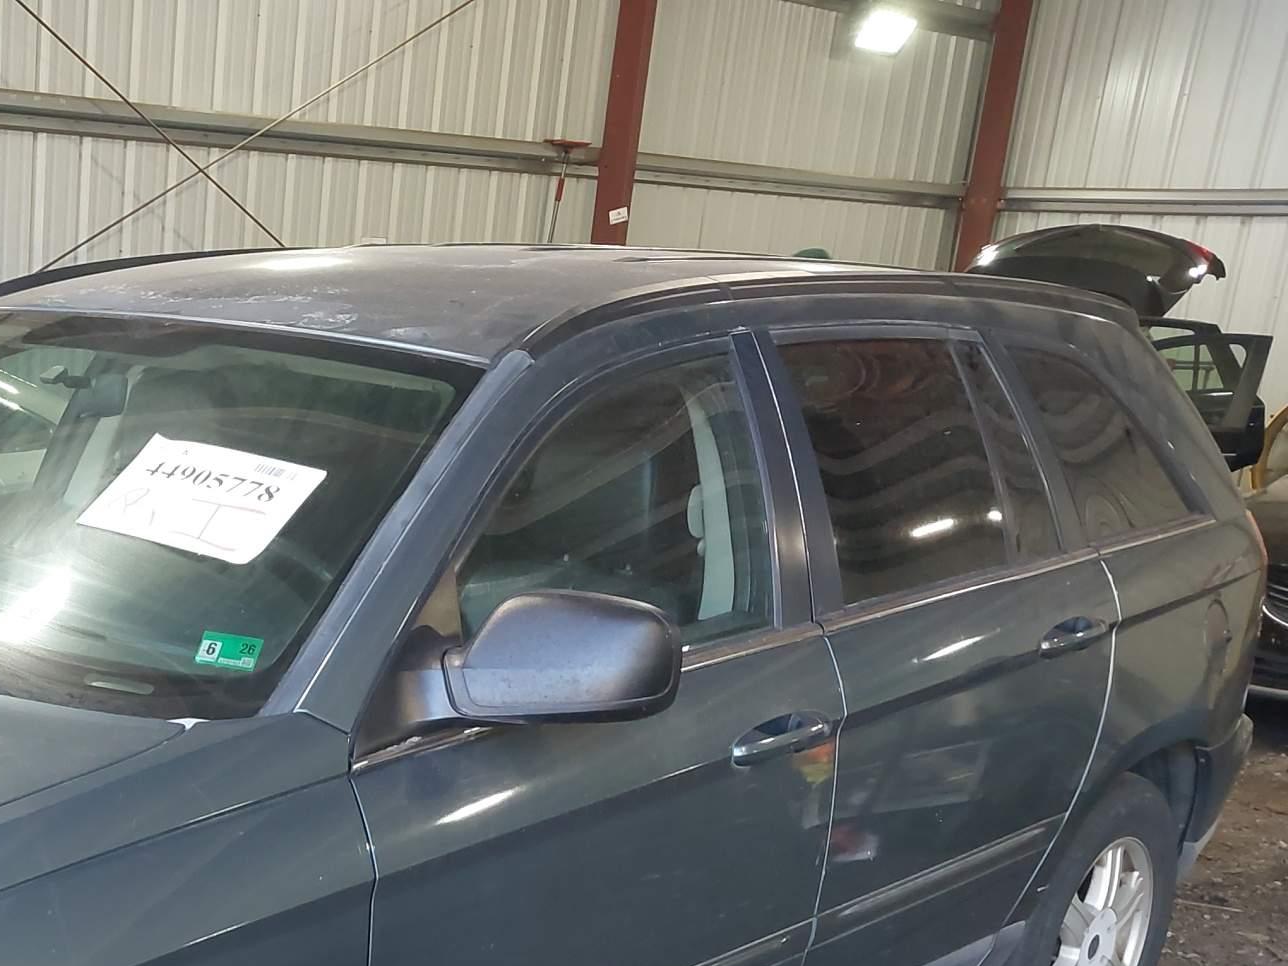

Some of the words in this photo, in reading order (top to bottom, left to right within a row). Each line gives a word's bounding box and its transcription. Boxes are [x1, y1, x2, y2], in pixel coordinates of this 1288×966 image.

[145, 461, 281, 503] 44905778
[205, 642, 218, 656] 6
[239, 642, 257, 655] 26
